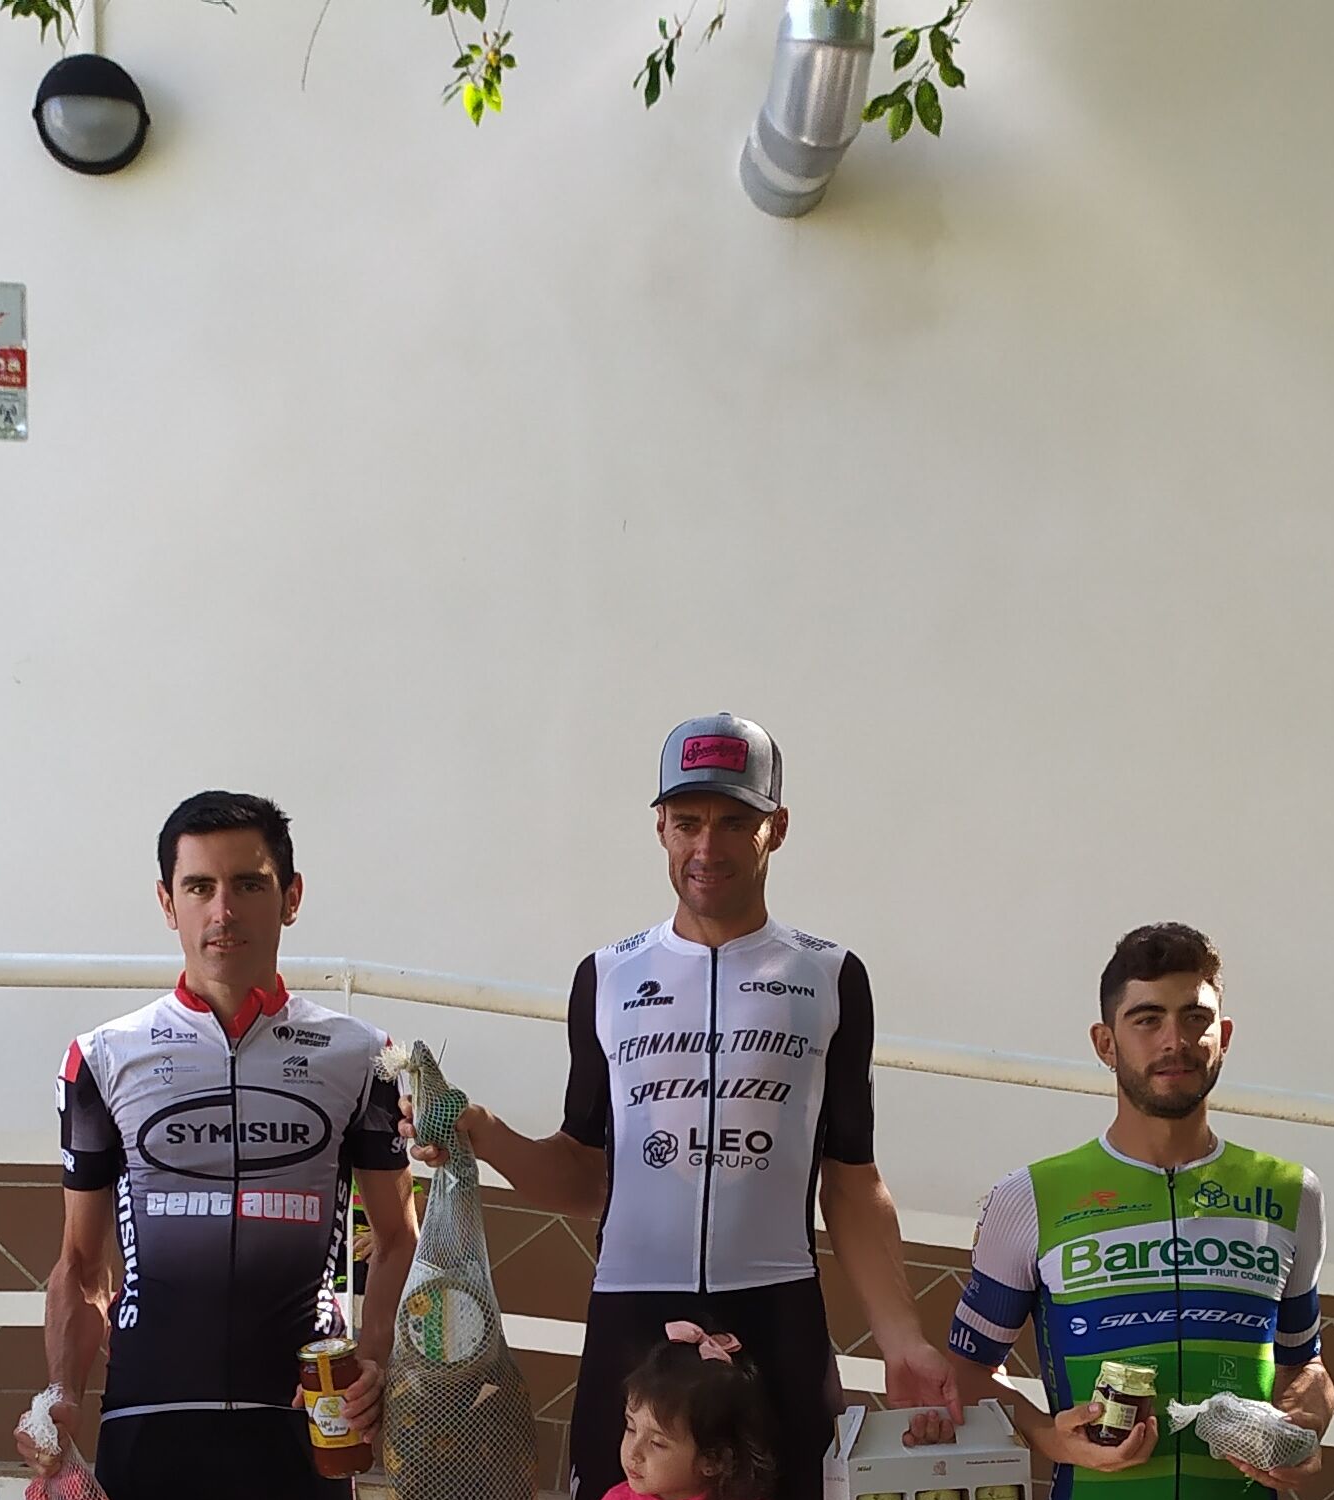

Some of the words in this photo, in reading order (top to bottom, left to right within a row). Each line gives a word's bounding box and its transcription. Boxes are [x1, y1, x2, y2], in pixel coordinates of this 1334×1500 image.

[739, 980, 815, 998] CROWN
[622, 996, 675, 1011] VIATOR
[731, 1029, 809, 1058] TORRES
[282, 1067, 309, 1078] SYM
[167, 1122, 311, 1145] SYMISUR
[689, 1127, 773, 1154] LEO
[688, 1152, 770, 1171] GRUPO
[1233, 1186, 1283, 1222] ulb
[117, 1172, 140, 1330] SYMISUR
[1061, 1236, 1280, 1281] Bargosa
[1209, 1268, 1239, 1278] FRUIT
[1097, 1307, 1273, 1332] SILVERBACK
[949, 1326, 977, 1355] ulb
